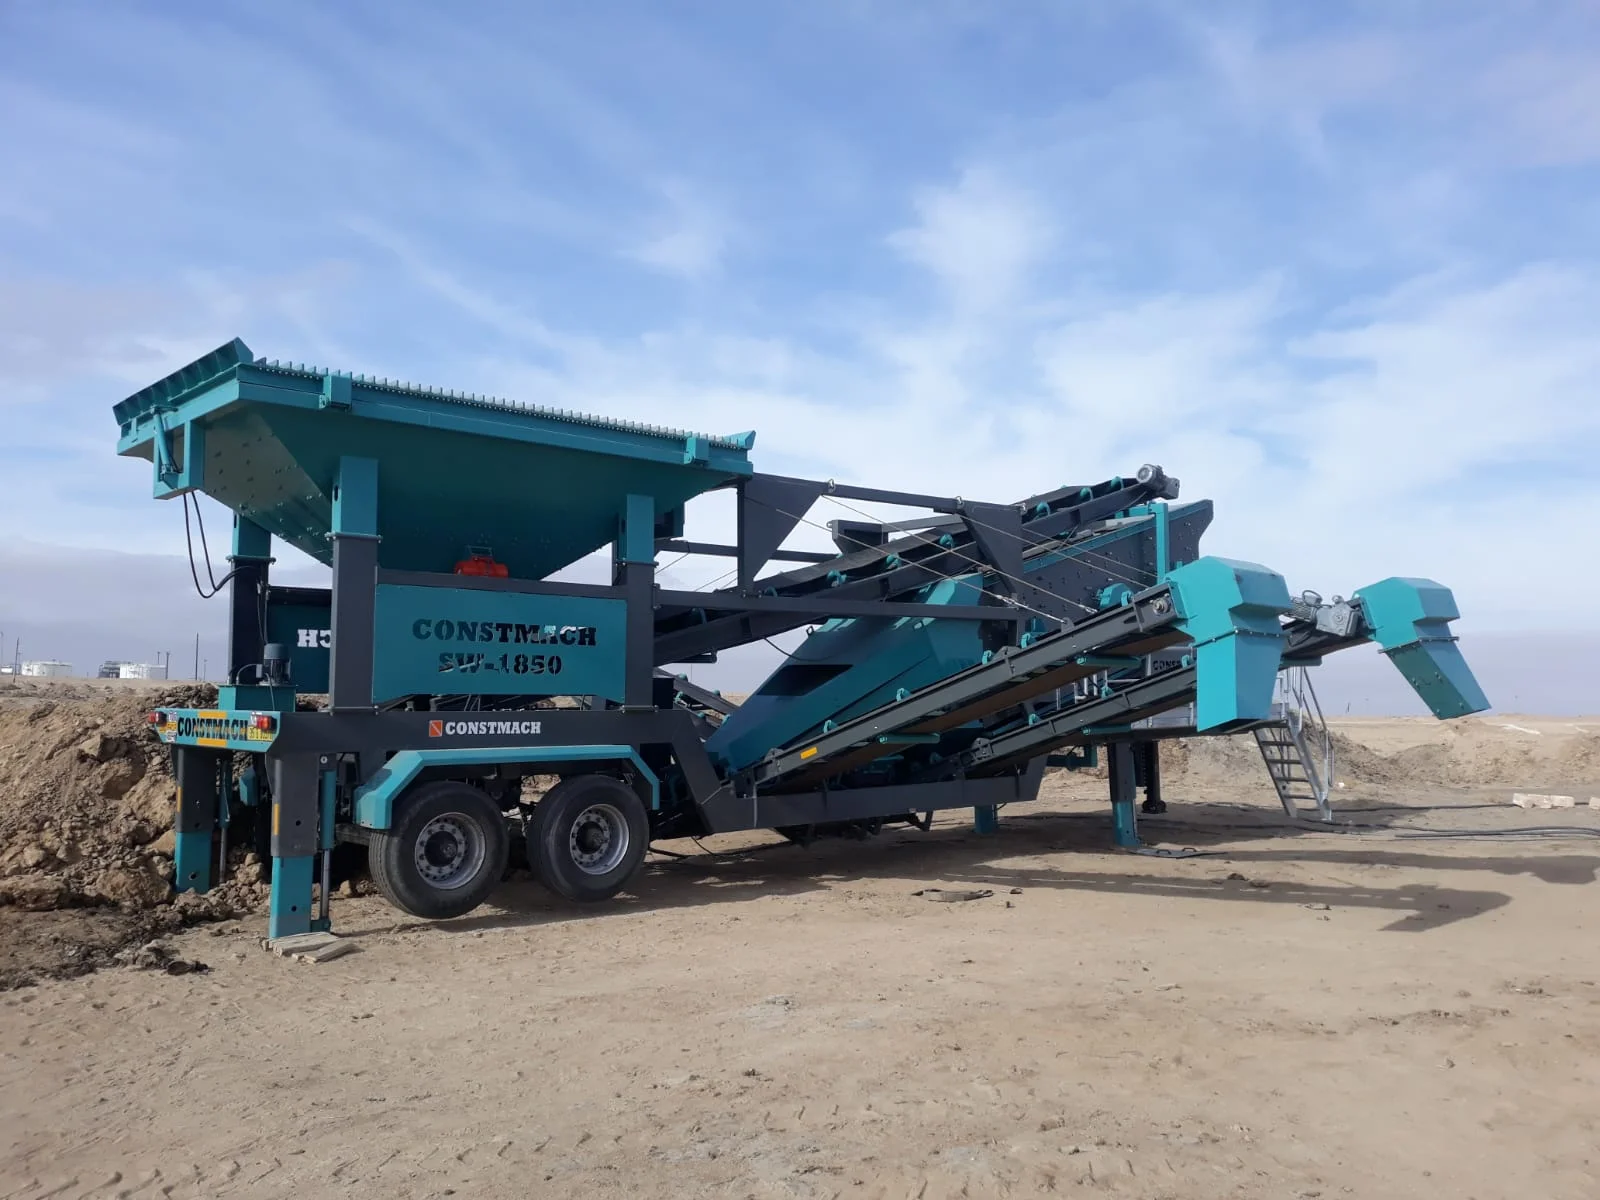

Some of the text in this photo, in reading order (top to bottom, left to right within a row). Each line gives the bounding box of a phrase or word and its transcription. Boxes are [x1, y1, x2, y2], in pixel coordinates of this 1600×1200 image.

[412, 619, 597, 646] CONSTMACH
[439, 652, 562, 675] SW-1850
[177, 716, 248, 741] CONSTMACH
[445, 721, 541, 735] CONSTMACH
